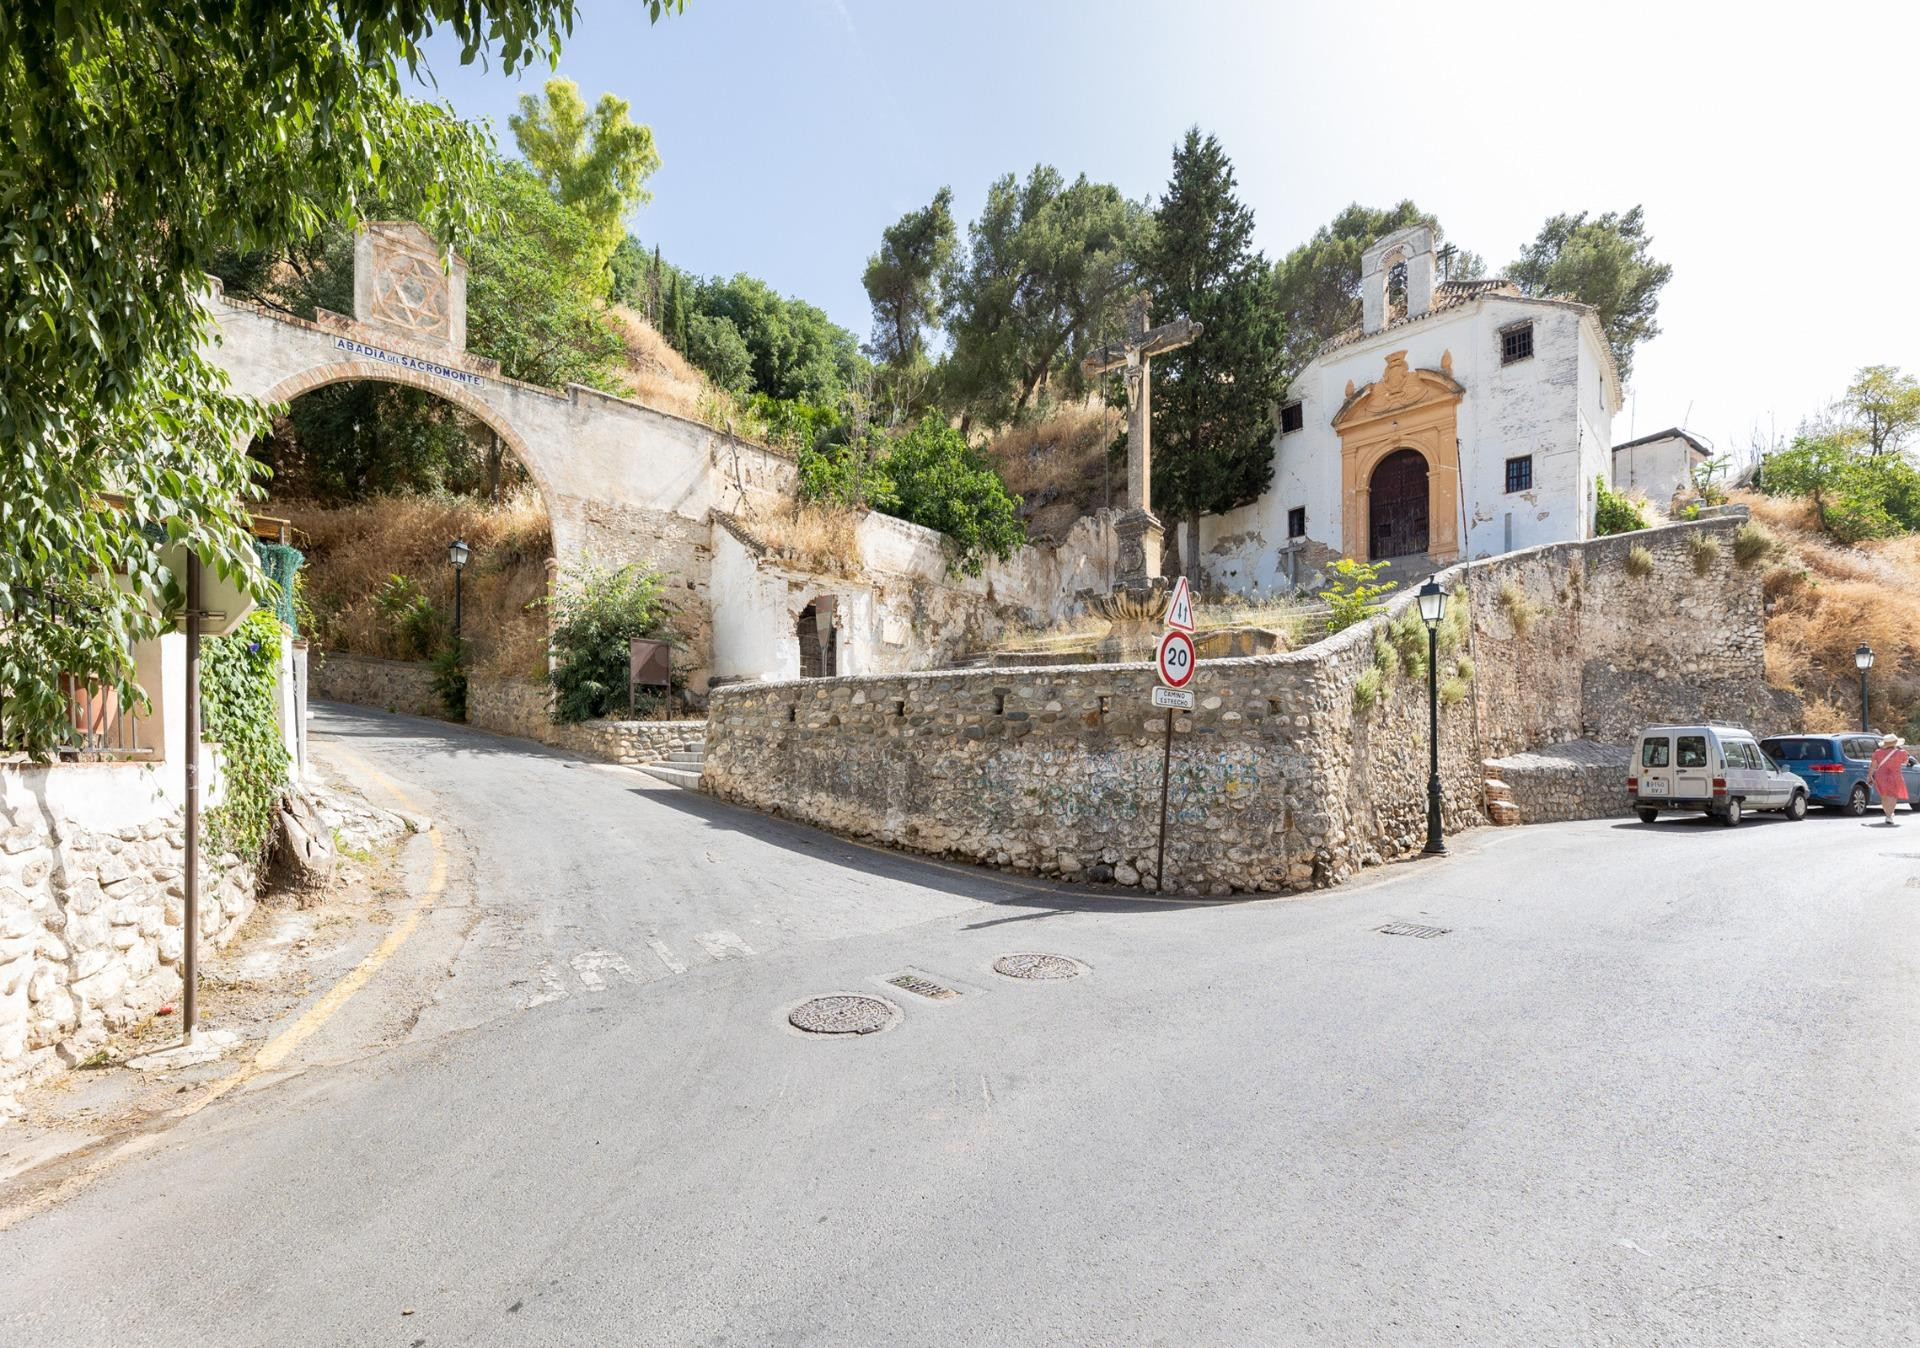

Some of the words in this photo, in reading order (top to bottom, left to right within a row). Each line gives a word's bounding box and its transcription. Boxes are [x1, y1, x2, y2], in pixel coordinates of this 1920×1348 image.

[387, 354, 400, 364] DEL
[401, 356, 481, 386] SACROMONTE
[1168, 647, 1187, 667] 20
[1159, 697, 1189, 707] ESTRECHO
[1163, 690, 1186, 700] CAMINO
